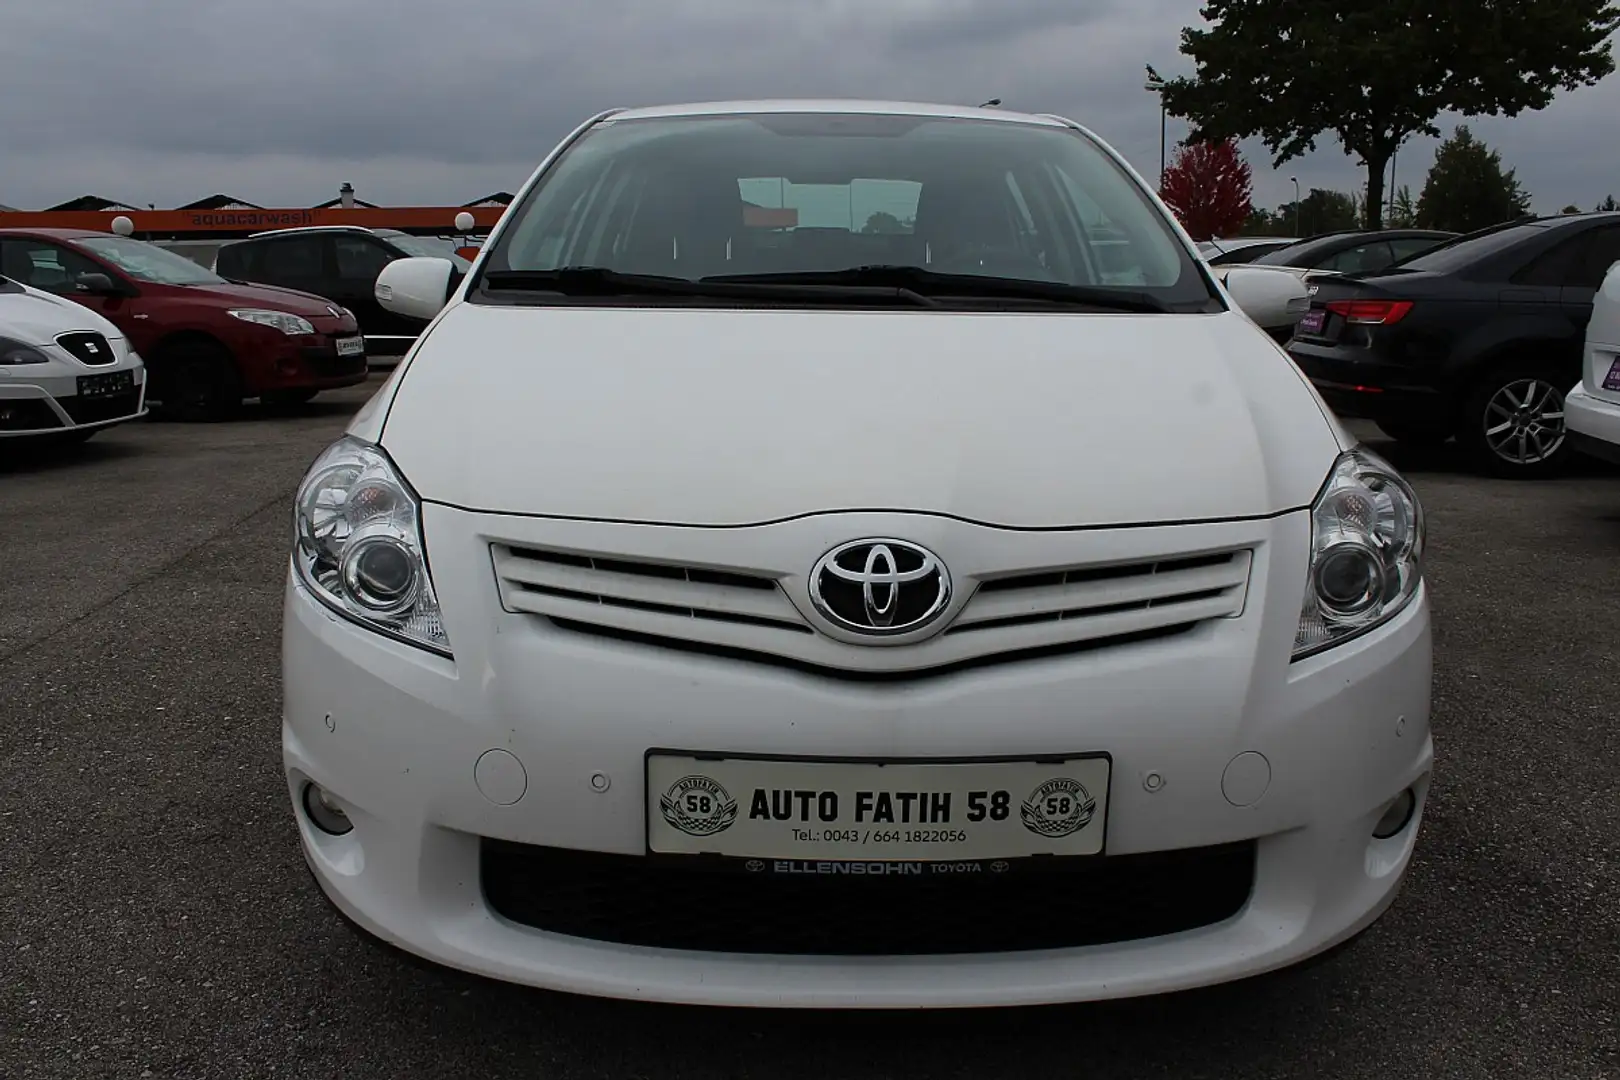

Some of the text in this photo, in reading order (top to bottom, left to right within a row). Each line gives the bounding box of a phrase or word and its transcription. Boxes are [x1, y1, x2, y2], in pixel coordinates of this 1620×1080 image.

[686, 795, 711, 814] 58
[749, 788, 1010, 823] AUTO FATIH 58
[1046, 797, 1070, 815] 58
[792, 828, 966, 845] Tel.: 0043 / 664 1822056
[773, 860, 982, 875] ELLENSOHN TOYOTA
